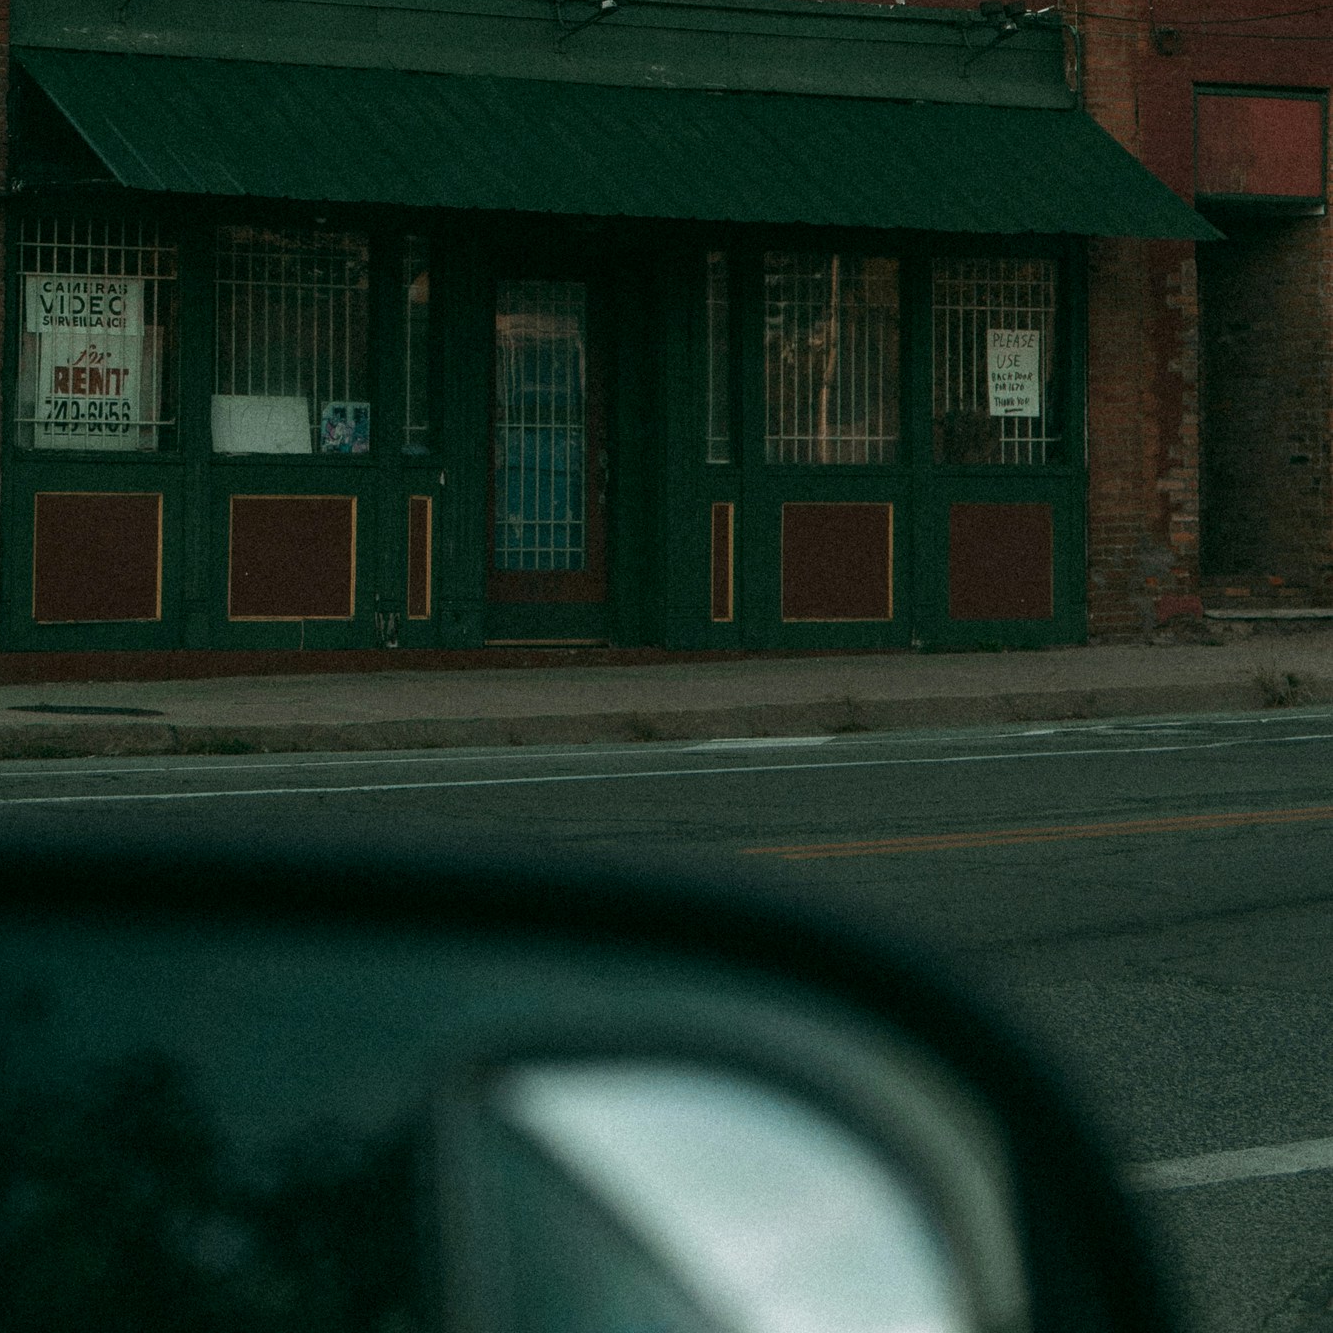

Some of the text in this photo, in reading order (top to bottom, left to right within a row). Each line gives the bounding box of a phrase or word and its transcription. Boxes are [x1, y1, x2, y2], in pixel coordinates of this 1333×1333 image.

[42, 281, 128, 294] CAMERAS
[40, 294, 126, 316] VIDEO
[42, 315, 126, 329] SURVEILLANCE
[992, 332, 1035, 348] PLEASE
[996, 354, 1020, 369] USE
[54, 366, 129, 396] RENT
[991, 371, 1033, 382] BACK DOOR
[995, 383, 1007, 392] FOR
[994, 396, 1015, 407] THANK
